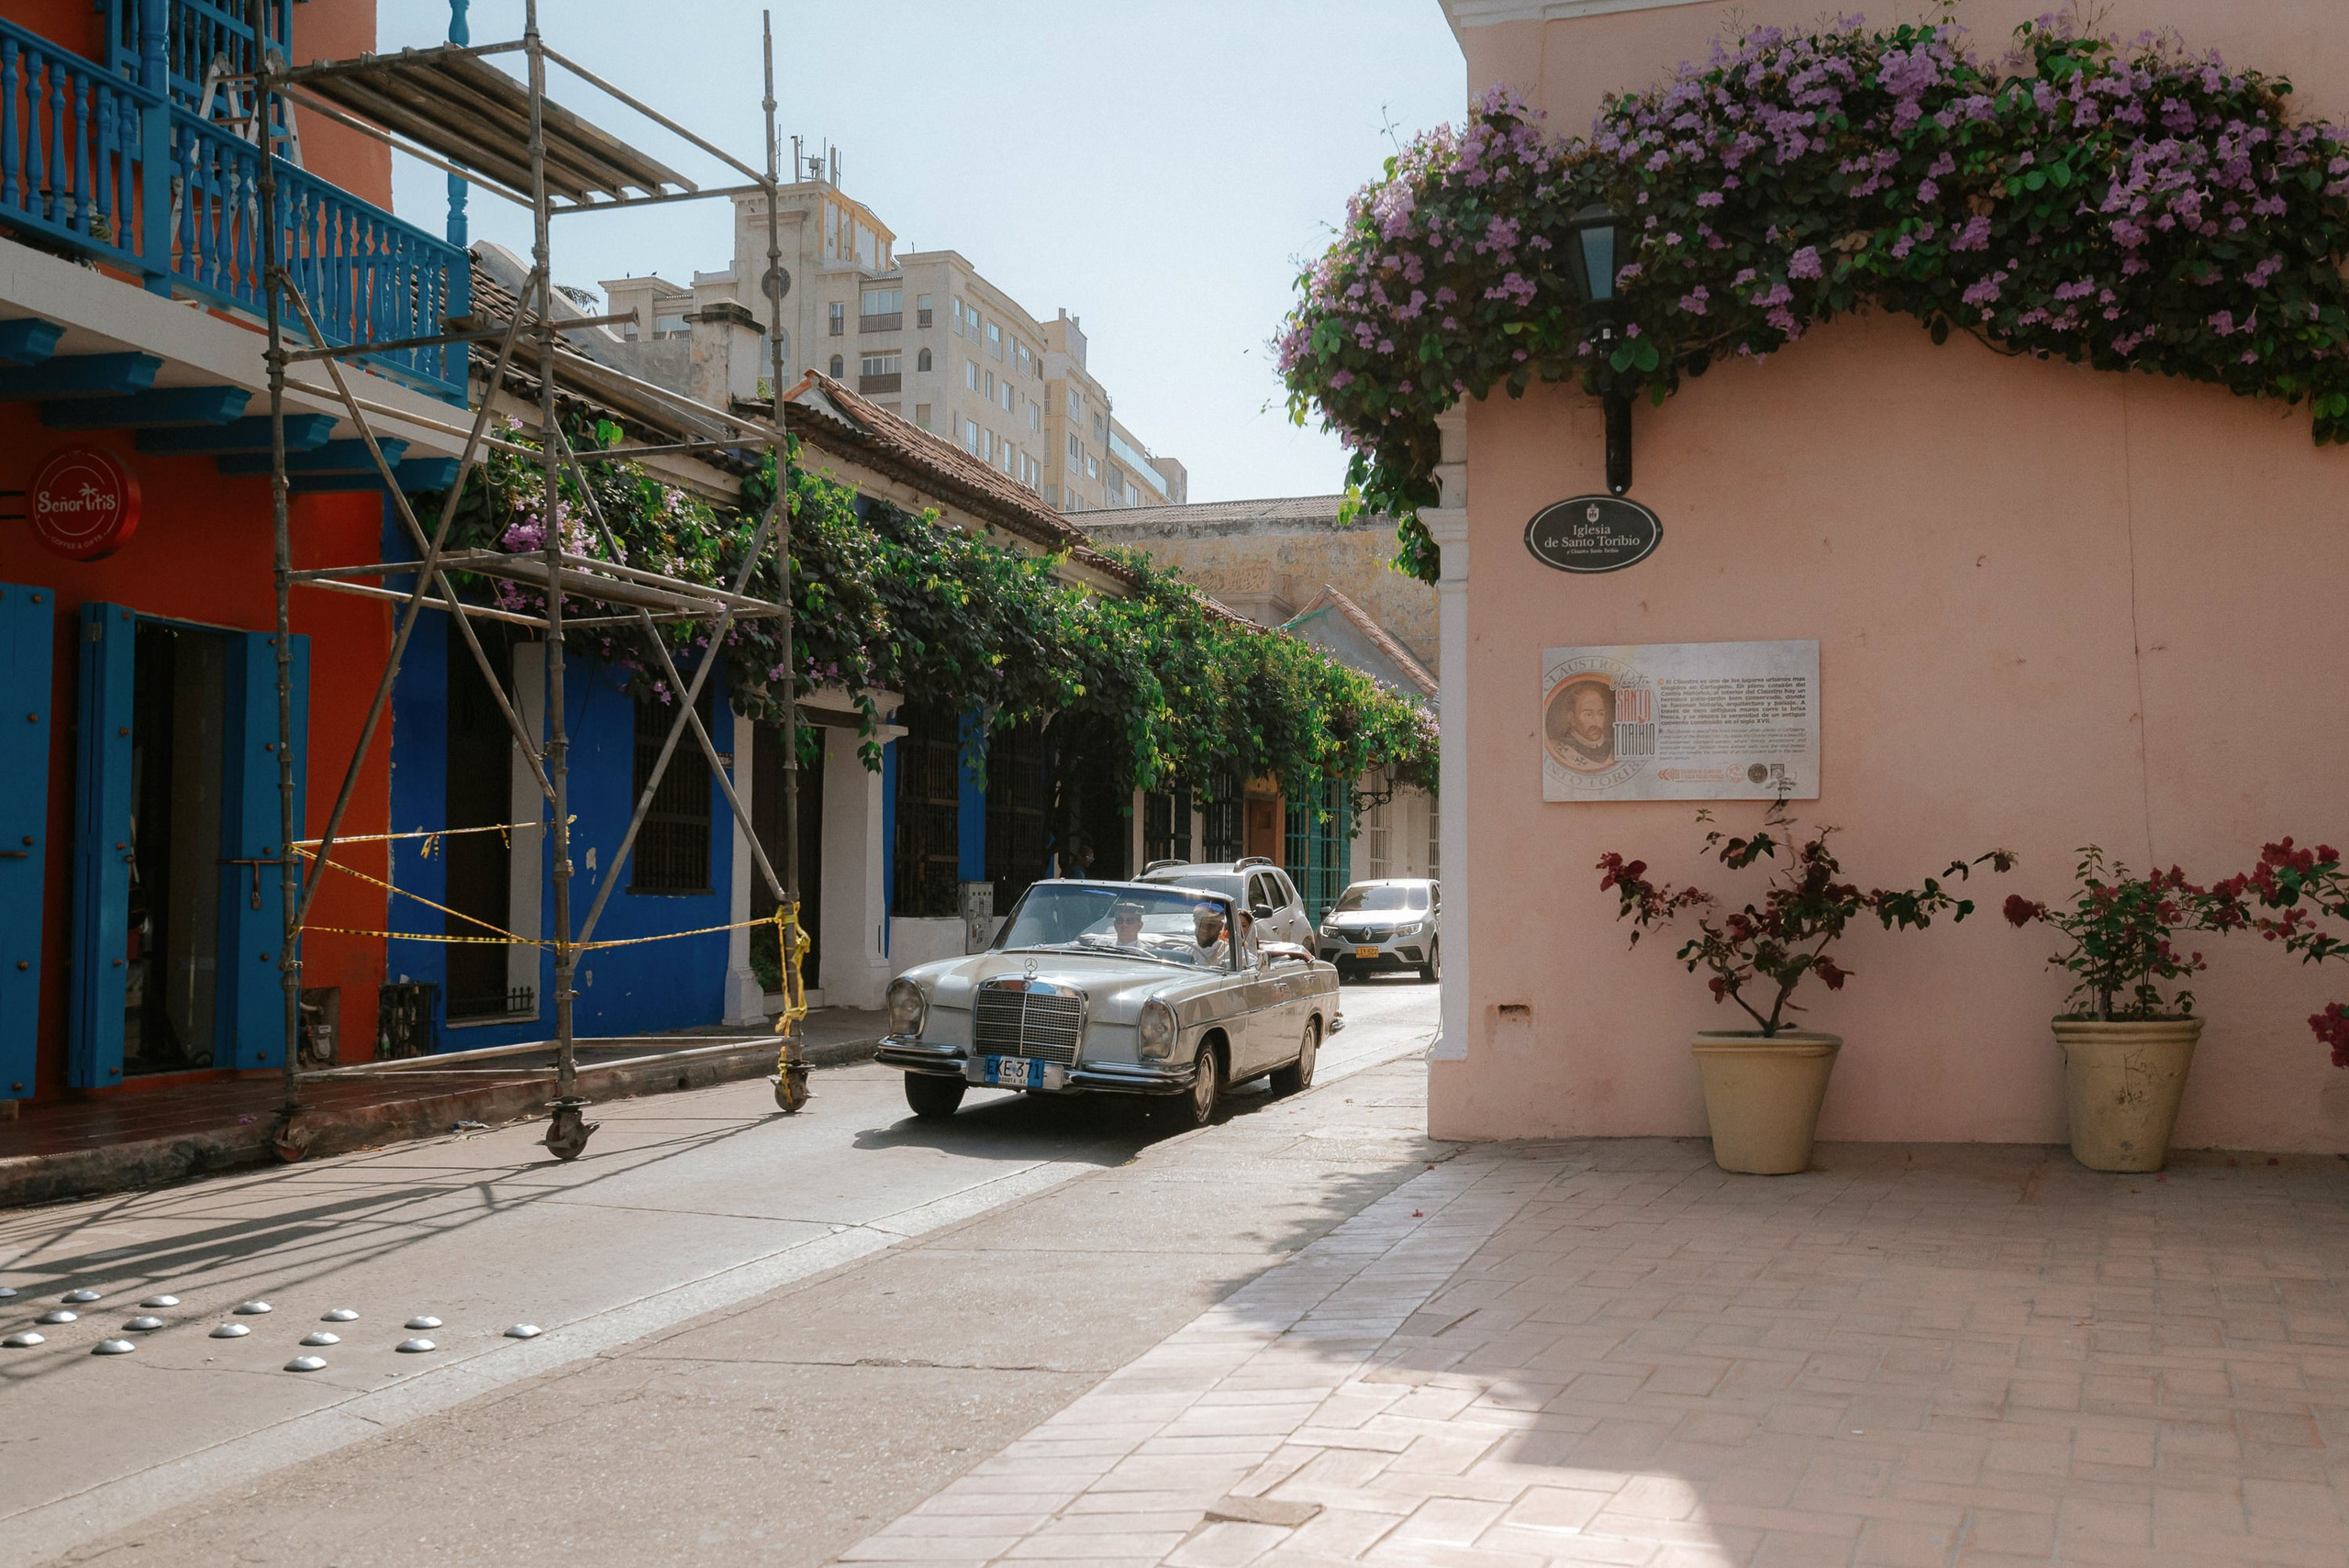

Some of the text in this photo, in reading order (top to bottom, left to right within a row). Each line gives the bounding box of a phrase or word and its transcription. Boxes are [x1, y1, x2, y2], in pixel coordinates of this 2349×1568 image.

[38, 491, 83, 513] Señor
[1544, 535, 1641, 548] de Santo Toribio
[1573, 524, 1611, 538] Iglesia
[1617, 689, 1652, 722] SANTO
[1614, 723, 1655, 756] TORIBIO
[986, 1058, 1040, 1080] EKE 371
